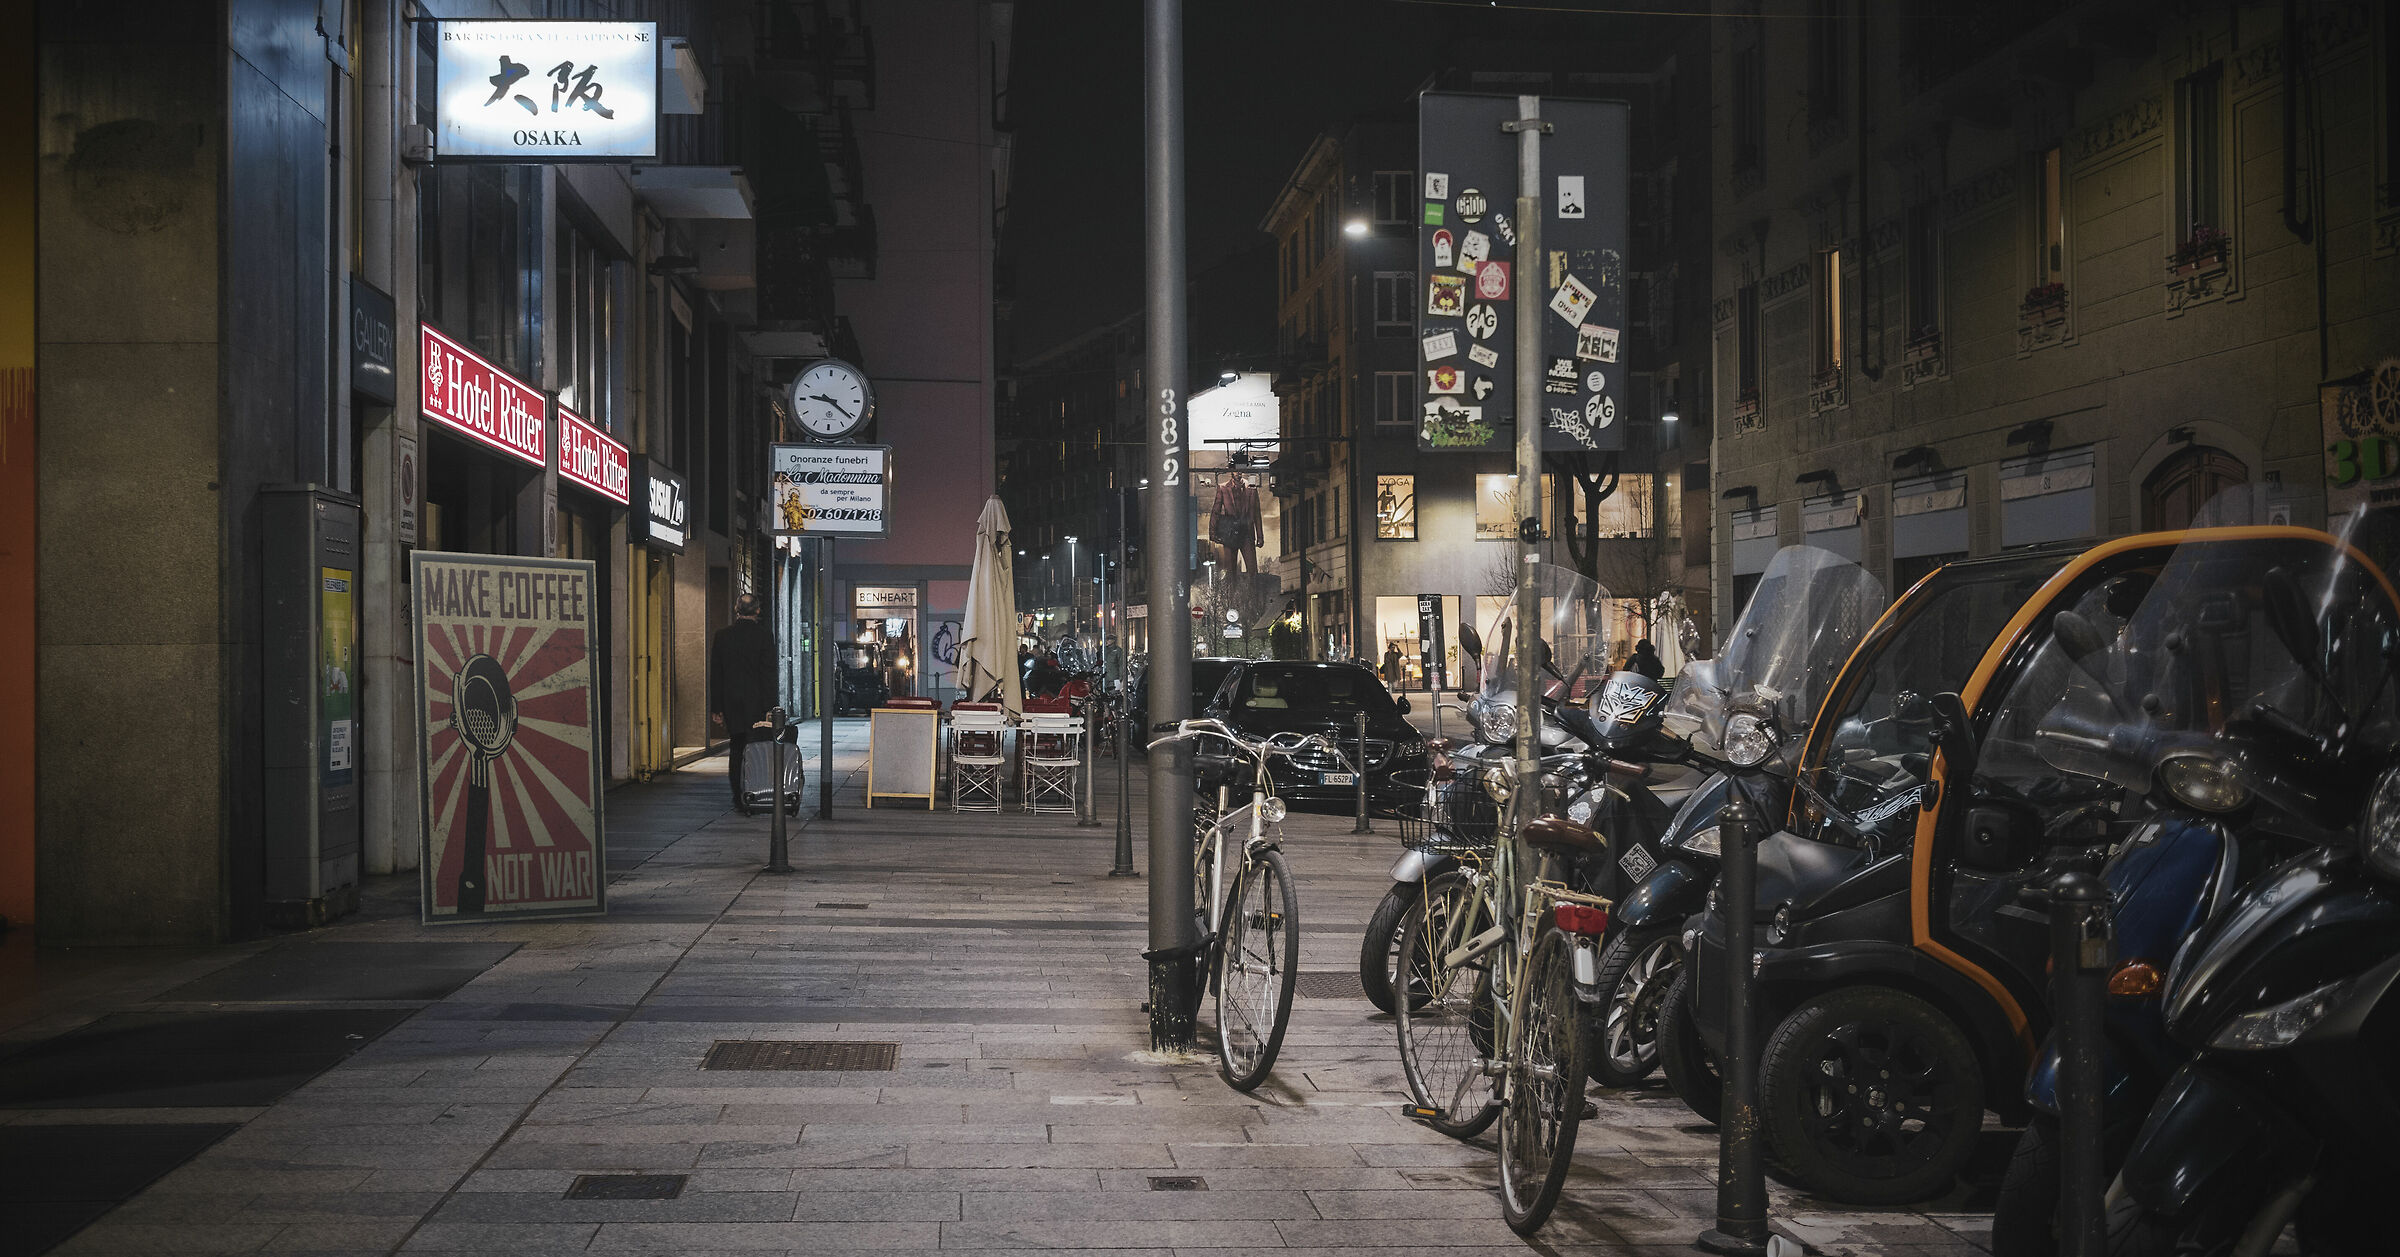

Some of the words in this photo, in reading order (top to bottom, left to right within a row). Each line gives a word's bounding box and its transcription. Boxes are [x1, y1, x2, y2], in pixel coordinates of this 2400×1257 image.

[484, 55, 614, 120] 大阪
[513, 130, 582, 146] OSAKA
[354, 307, 393, 367] GALLERY
[446, 352, 495, 435] Hotel
[499, 382, 542, 456] Ritter
[572, 425, 600, 484] Hotel
[601, 442, 627, 498] Ritter
[782, 464, 801, 487] La
[804, 467, 881, 485] Madonnina
[790, 455, 833, 464] Onoranze
[835, 456, 868, 464] funebri
[1381, 478, 1410, 486] YOGA
[649, 476, 671, 521] SUSHI
[424, 567, 490, 618] MAKE
[499, 570, 585, 622] COFFEE
[859, 592, 915, 603] BENHEART
[487, 852, 534, 901] NOT
[539, 850, 592, 899] WAR
